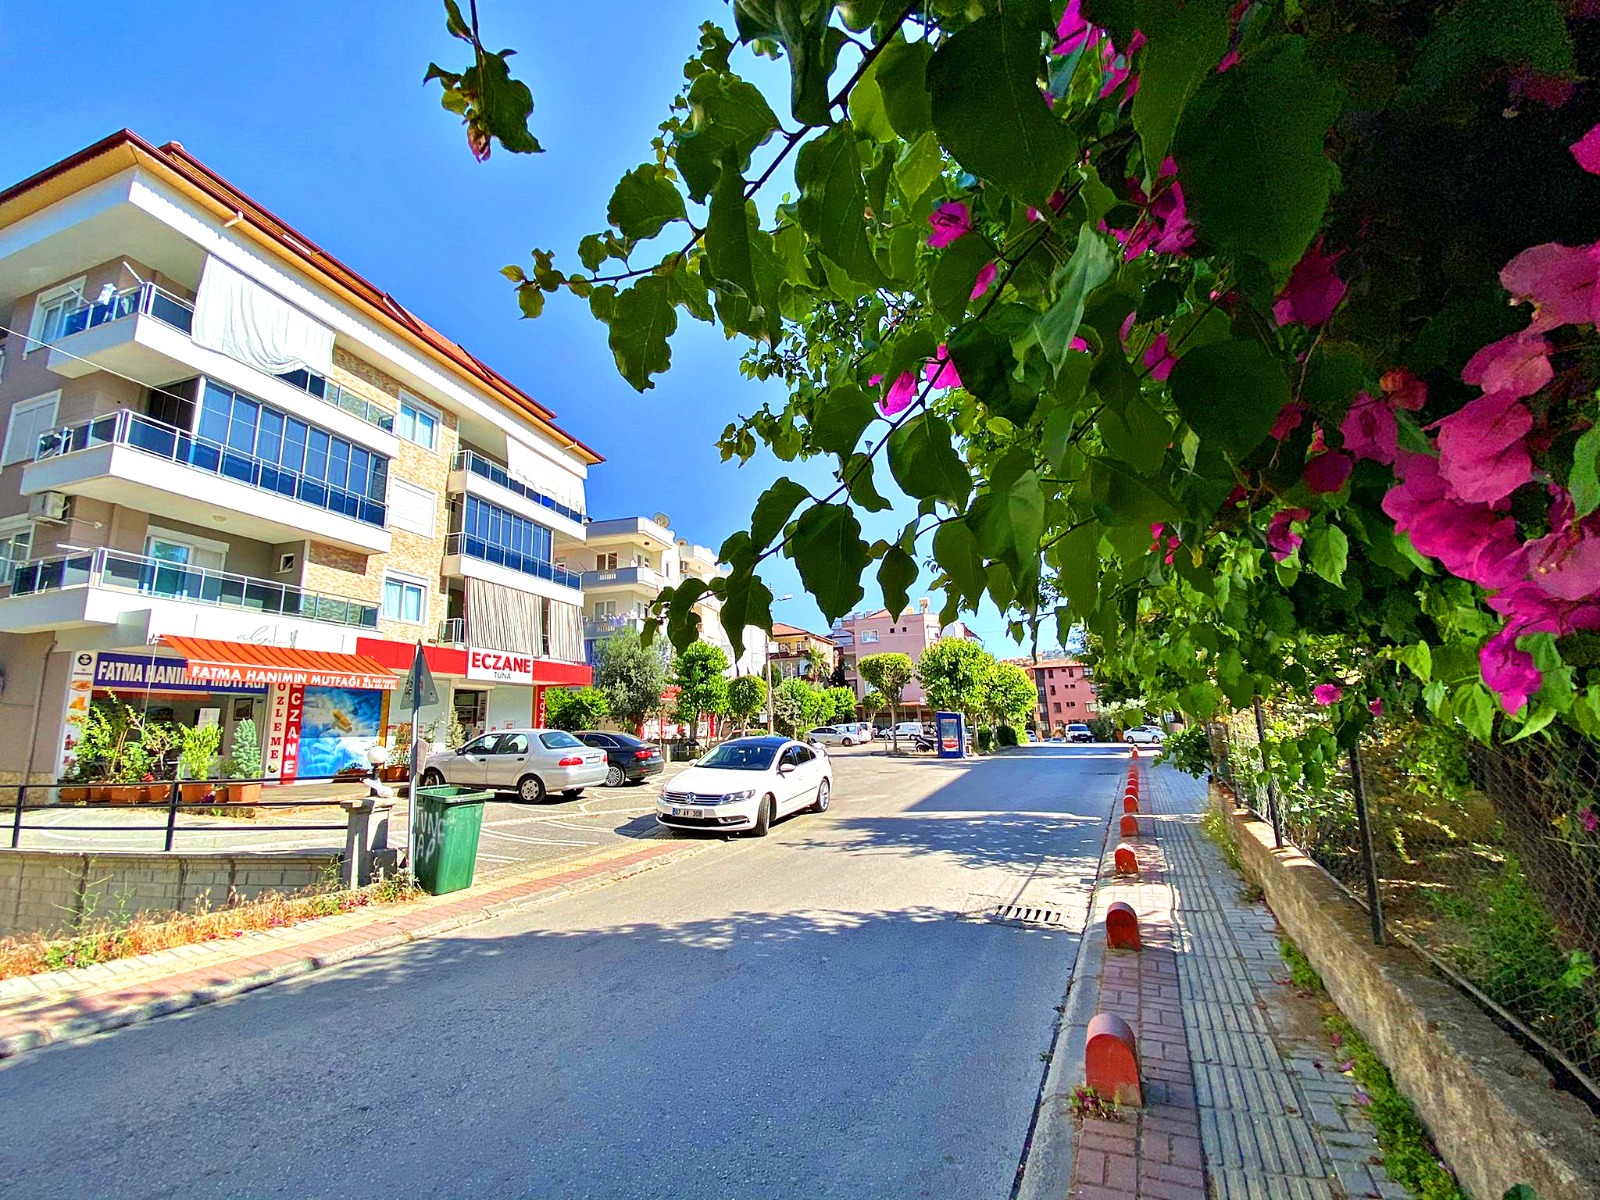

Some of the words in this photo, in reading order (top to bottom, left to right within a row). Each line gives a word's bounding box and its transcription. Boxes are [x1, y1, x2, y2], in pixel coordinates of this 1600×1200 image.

[97, 661, 142, 682] FATMA
[472, 652, 531, 673] ECZANE
[192, 666, 242, 680] FATMA
[245, 670, 307, 684] HANIMIN
[311, 674, 360, 688] MUTFAĞI
[283, 684, 303, 774] CZANE
